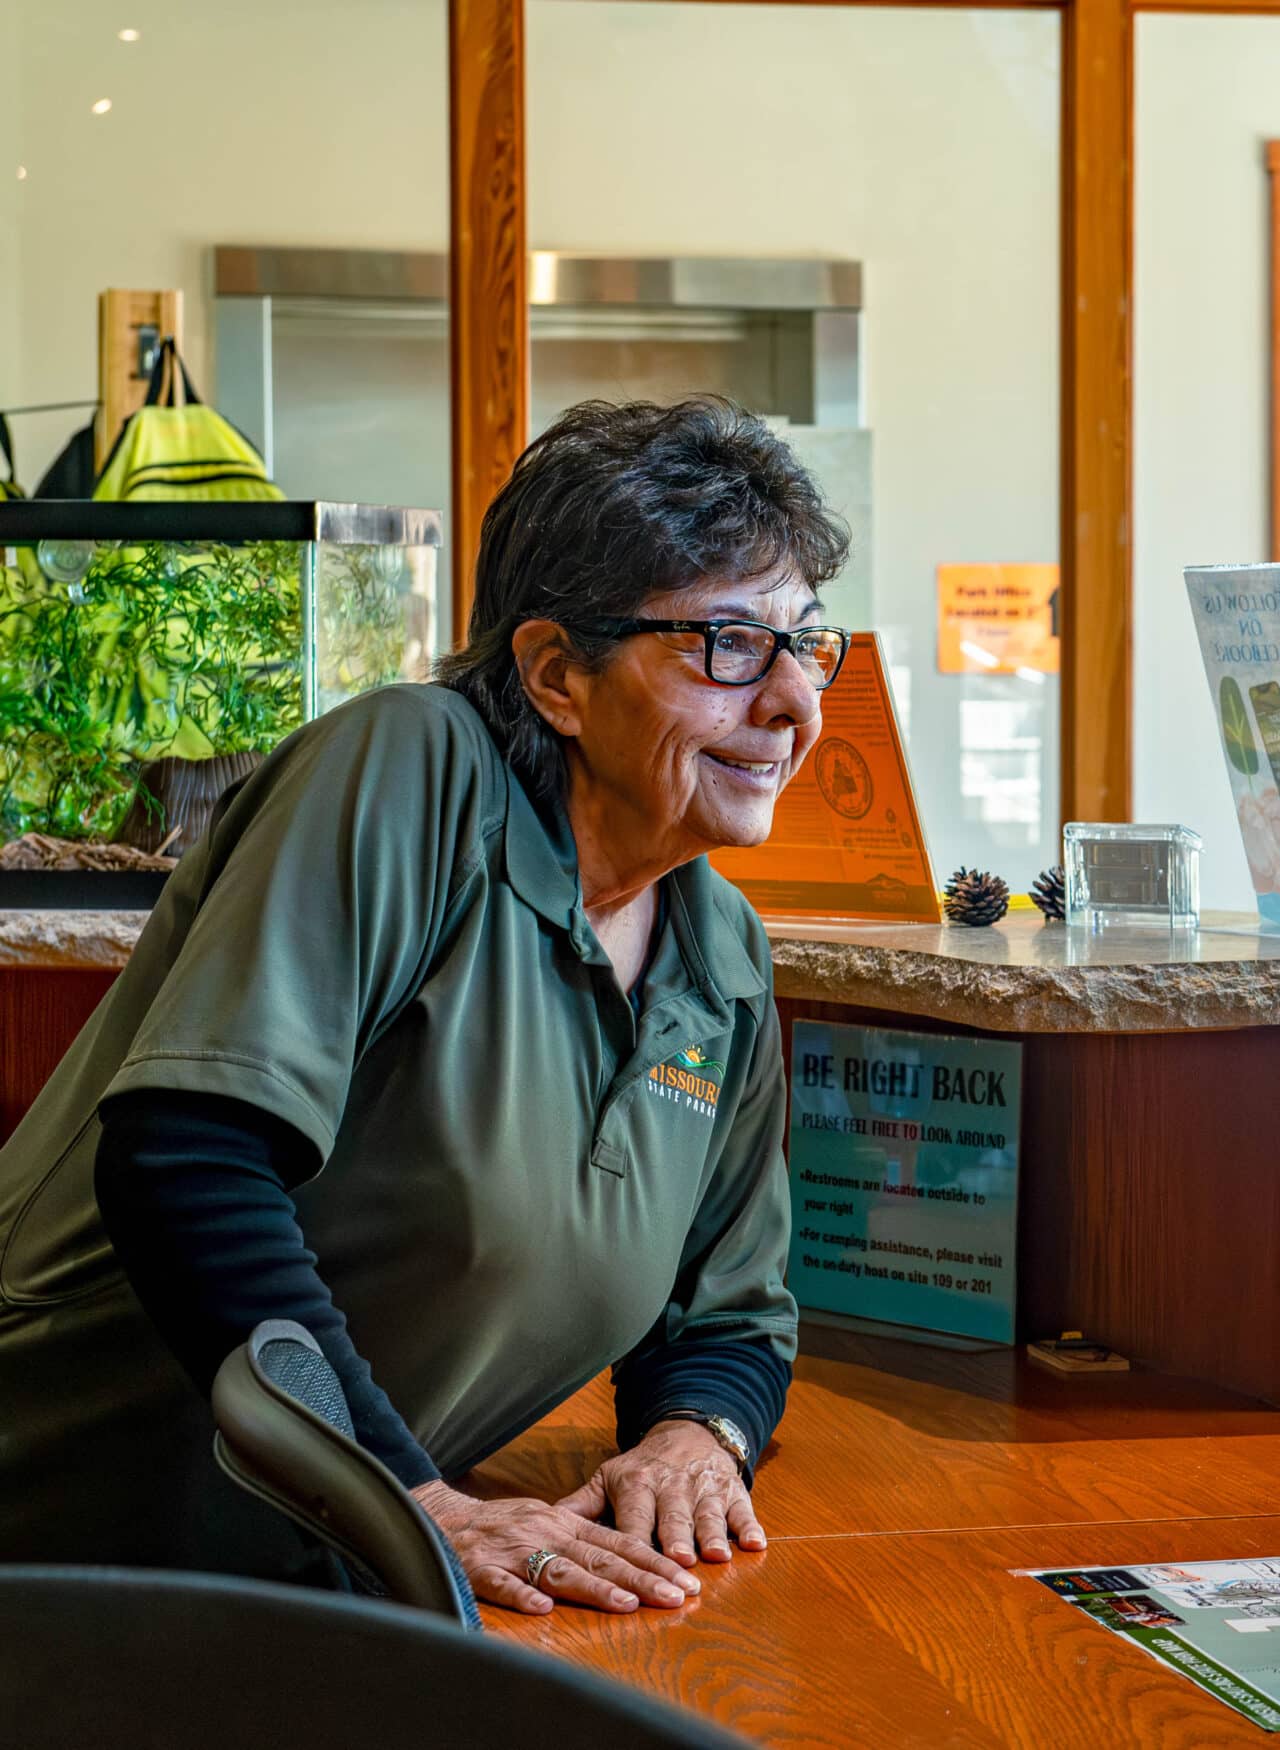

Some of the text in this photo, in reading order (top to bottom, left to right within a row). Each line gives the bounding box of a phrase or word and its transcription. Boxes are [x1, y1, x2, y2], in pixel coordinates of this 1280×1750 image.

[648, 1080, 680, 1103] STATE
[803, 1053, 1006, 1107] BE RIGHT BACK
[802, 1112, 1006, 1149] PLEASE FEEL FREE TO LOOK AROUND
[805, 1168, 986, 1206] Restrooms are located outside to
[804, 1199, 854, 1217] your right
[803, 1227, 1003, 1268] For camping assistance, please visit
[803, 1255, 820, 1268] the
[864, 1262, 888, 1279] host
[892, 1269, 905, 1281] on
[908, 1269, 928, 1286] site
[932, 1273, 952, 1290] 109
[955, 1279, 968, 1291] or
[971, 1277, 992, 1295] 201
